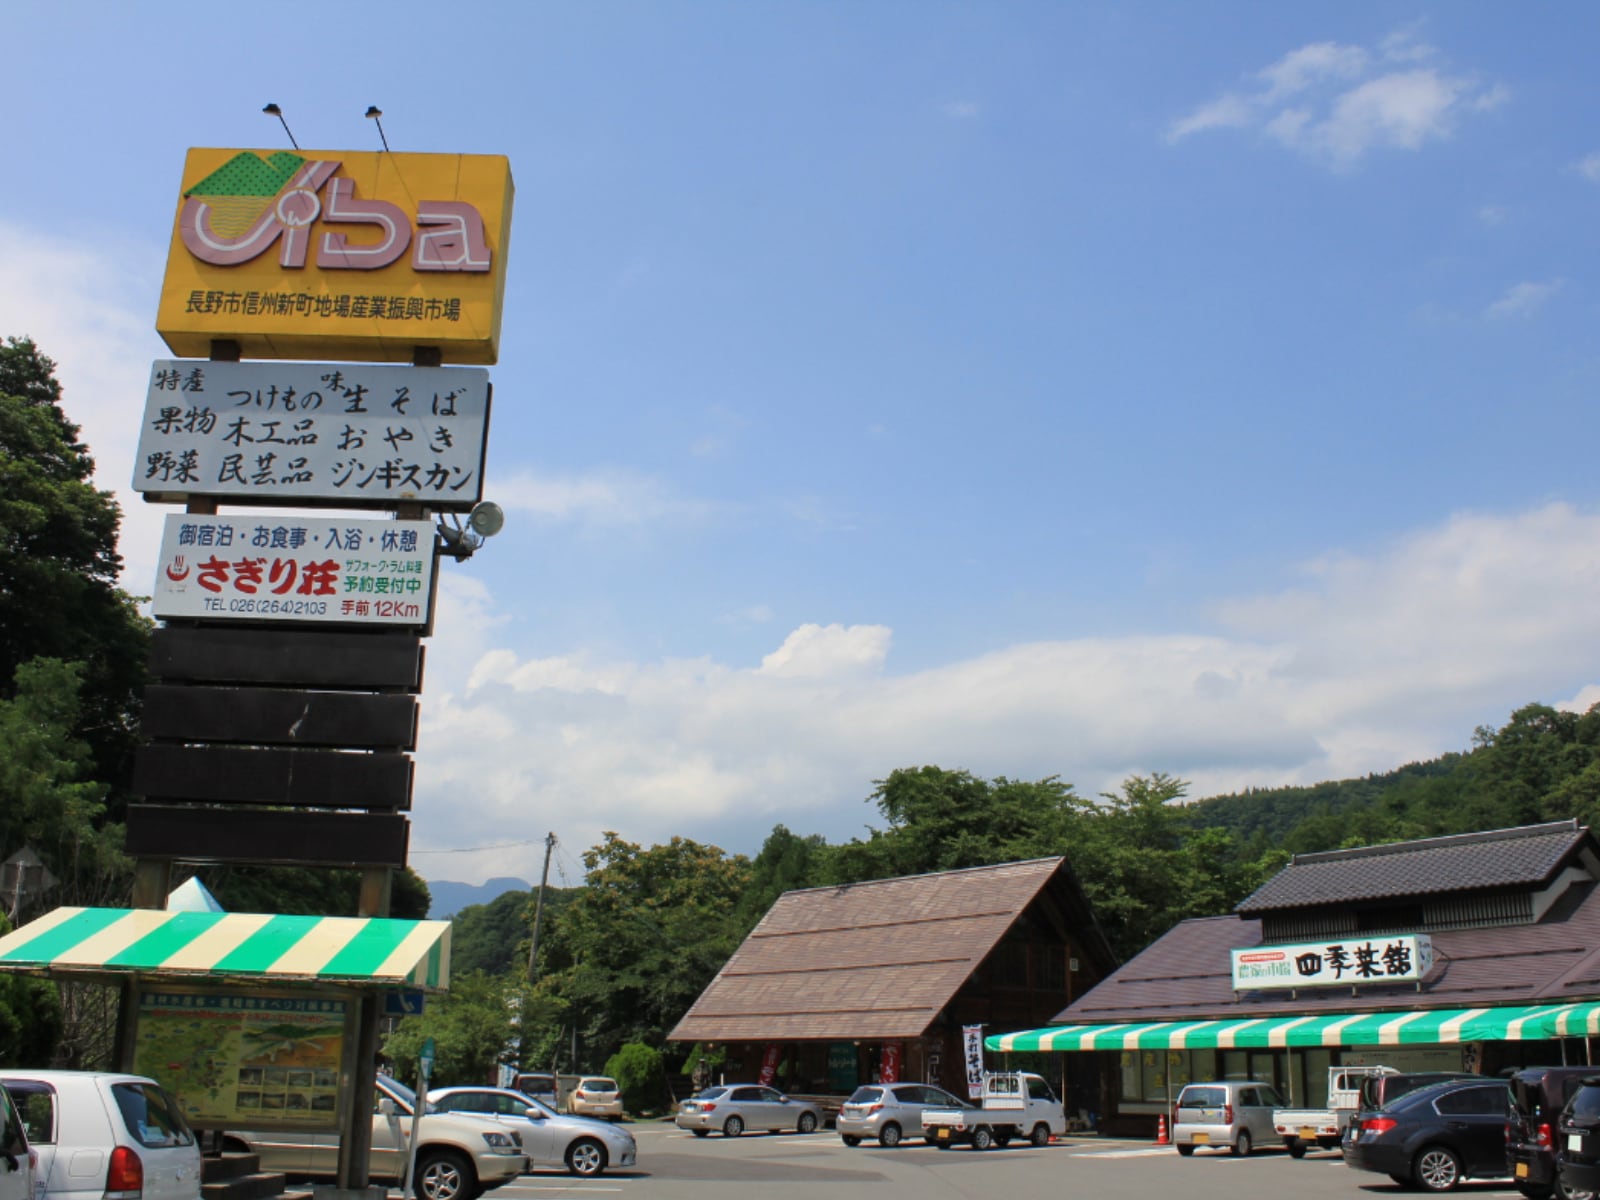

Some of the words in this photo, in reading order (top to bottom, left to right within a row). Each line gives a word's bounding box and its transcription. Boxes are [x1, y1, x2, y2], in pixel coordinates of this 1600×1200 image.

[185, 290, 461, 321] 長野市信州新町地場産業振興市場
[155, 368, 206, 393] 特産
[320, 370, 345, 391] 味
[226, 387, 324, 411] つけもの
[152, 407, 217, 435] 果物
[222, 416, 319, 447] 木工品
[337, 424, 454, 453] おやき
[145, 450, 200, 483] 野菜
[217, 452, 315, 485] 民芸品
[331, 460, 473, 492] ジンギスカン
[197, 555, 341, 596] さぎり荘
[344, 575, 422, 595] 予約受付中
[204, 598, 227, 612] TEL
[230, 599, 327, 615] 026(264)2103
[340, 600, 370, 617] 手前
